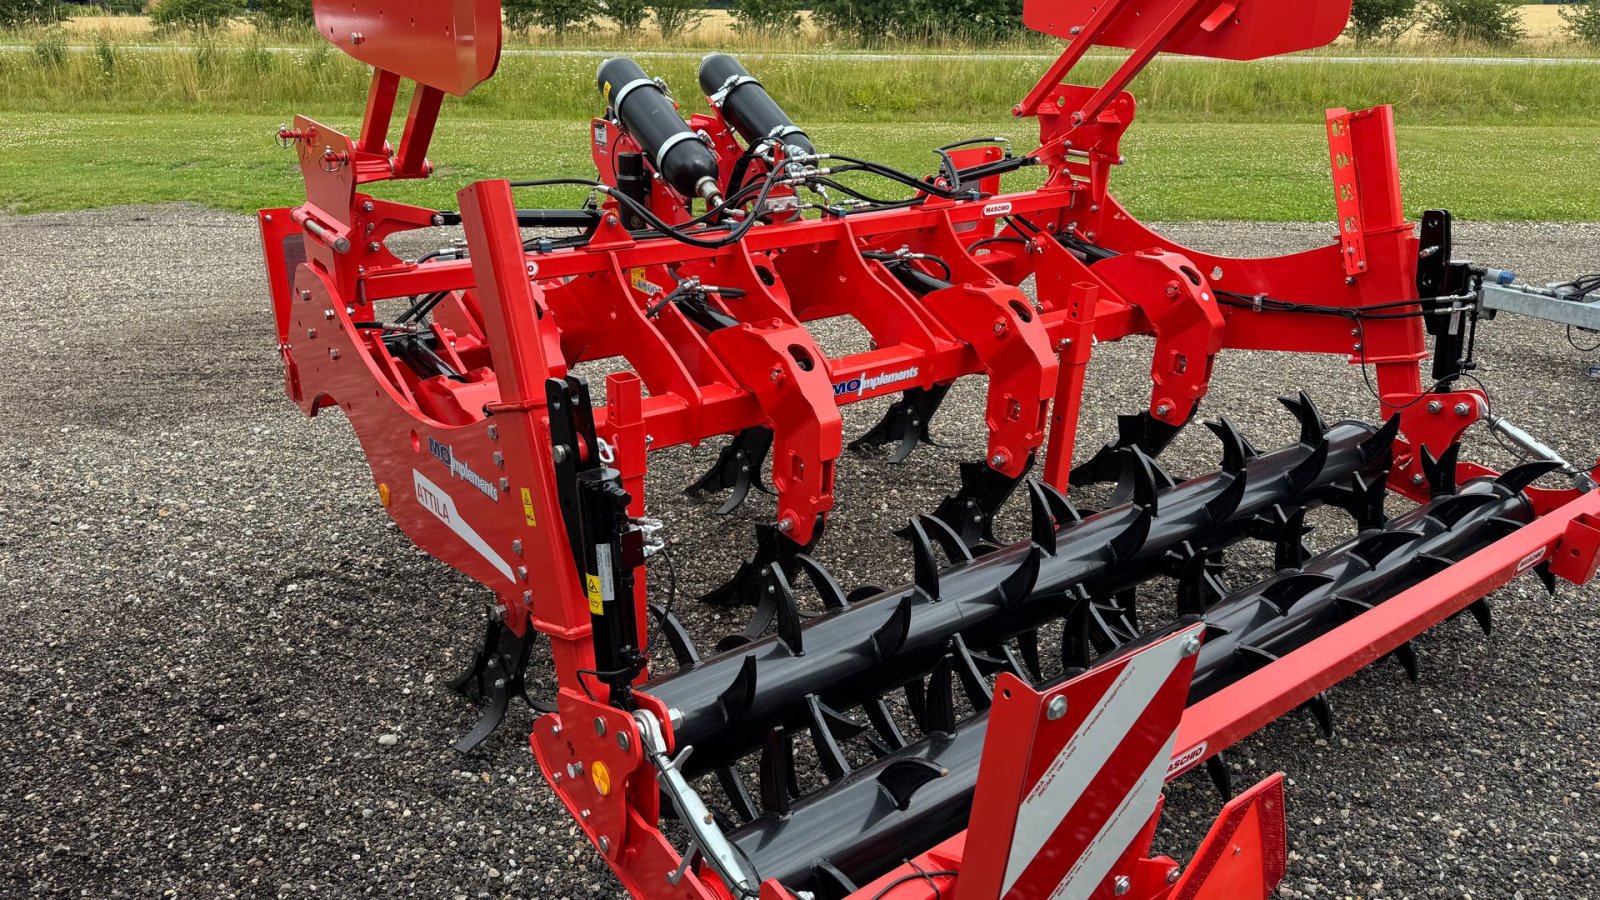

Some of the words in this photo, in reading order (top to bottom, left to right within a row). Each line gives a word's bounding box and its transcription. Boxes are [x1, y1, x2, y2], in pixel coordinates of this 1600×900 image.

[985, 204, 1010, 213] MASCHIO
[417, 482, 451, 525] ATTILA
[1166, 746, 1203, 773] ASCHIO
